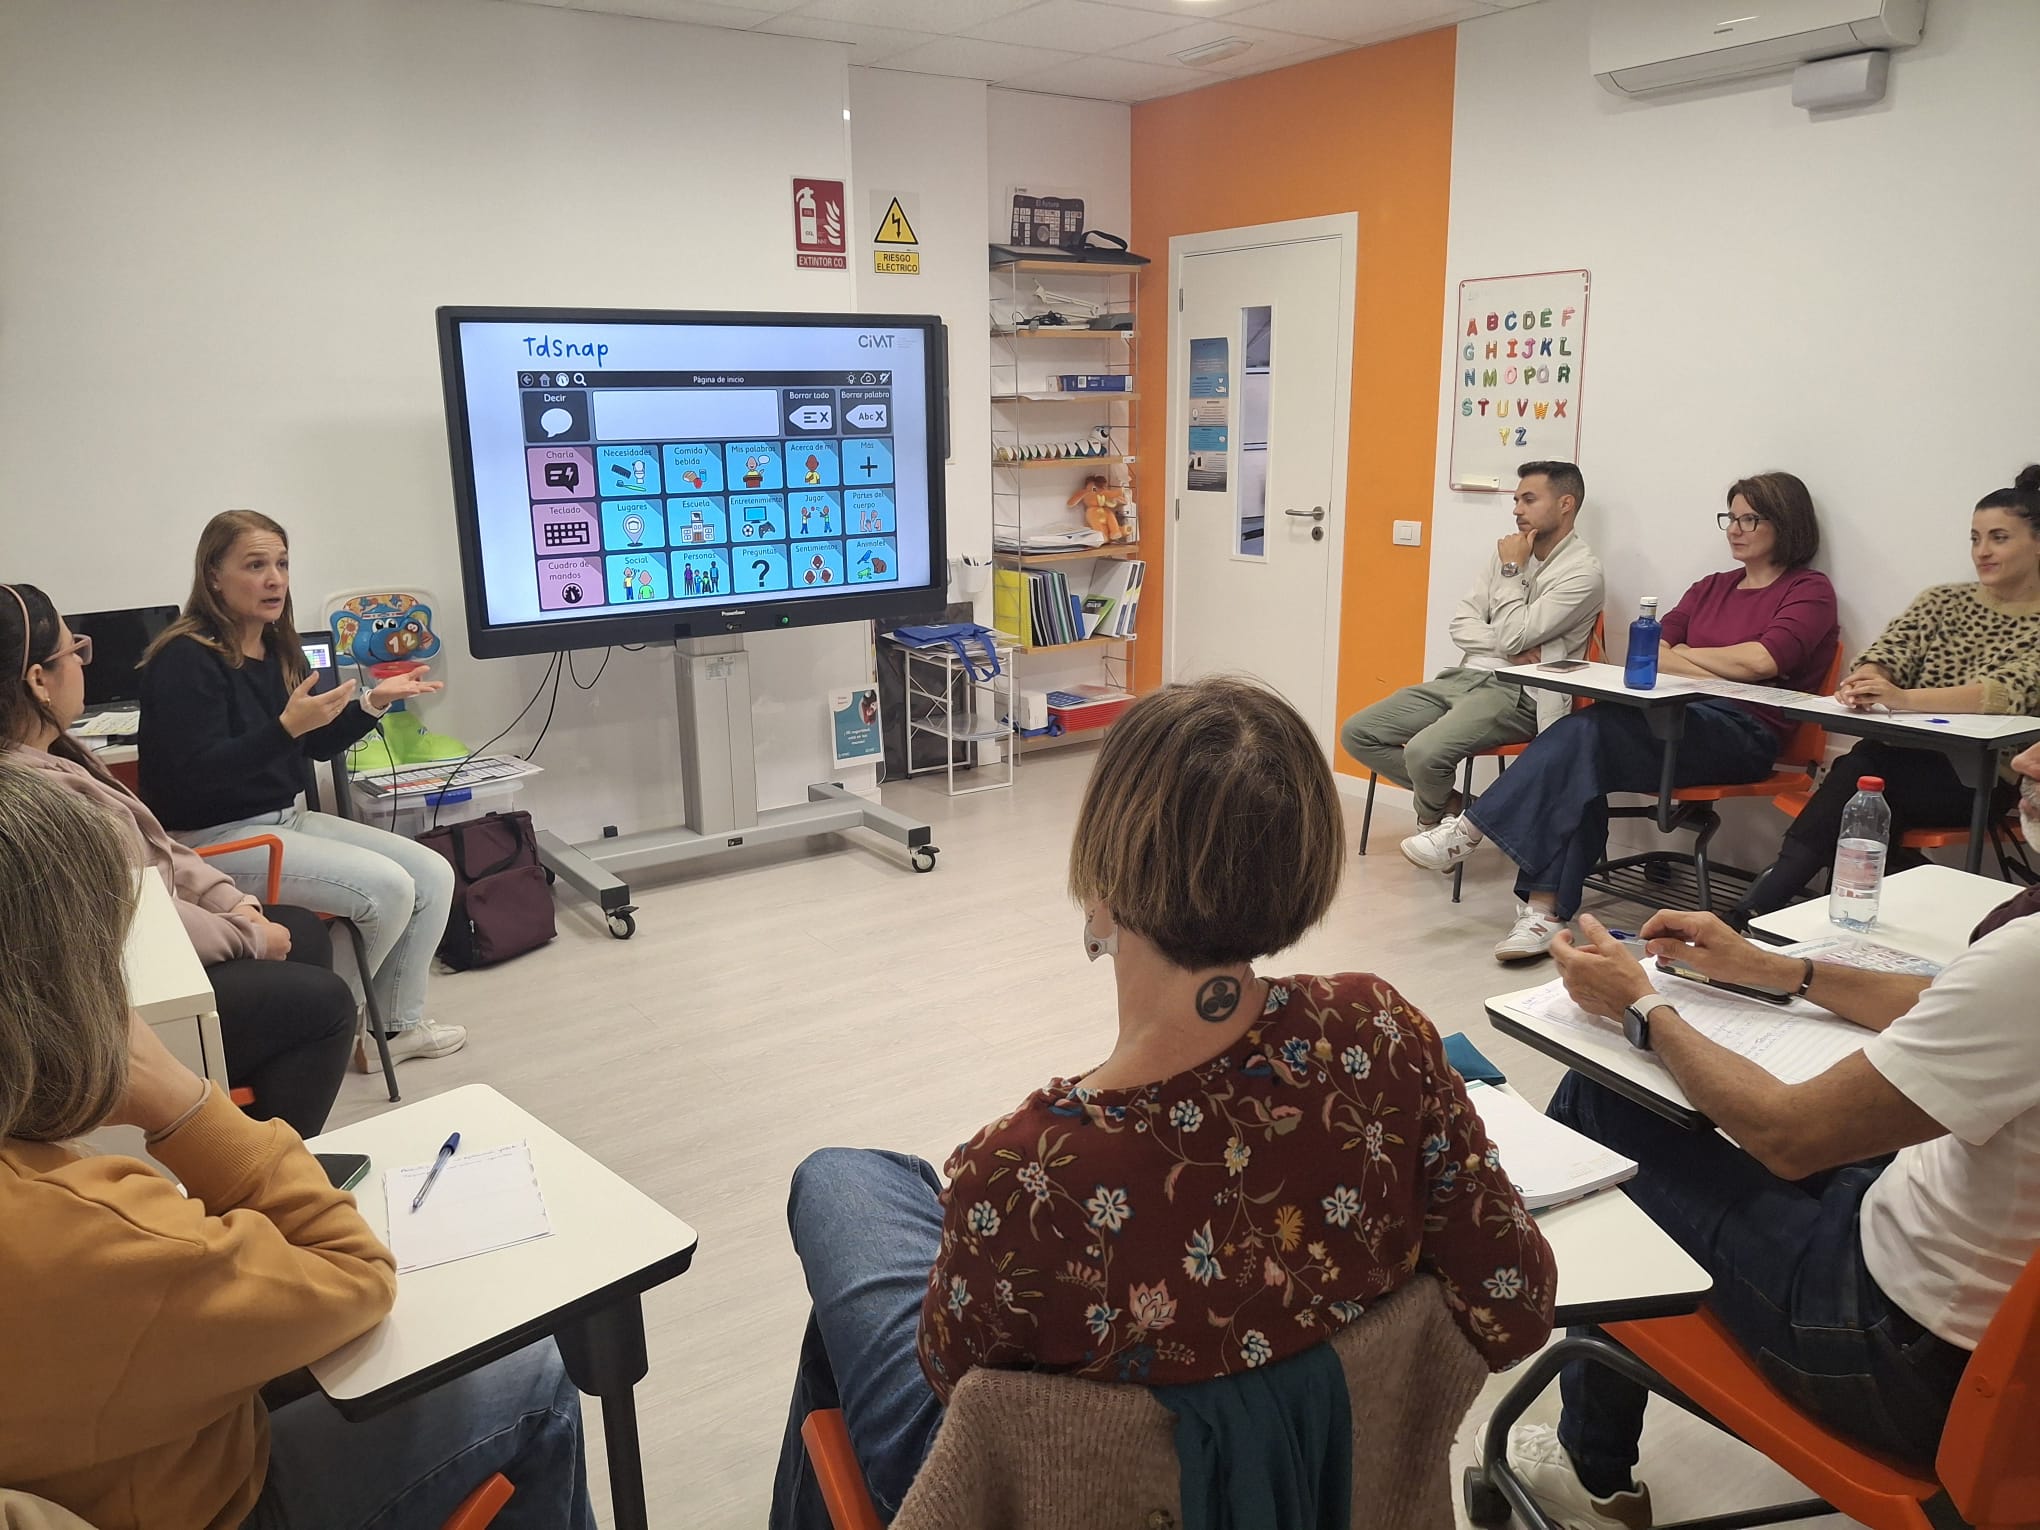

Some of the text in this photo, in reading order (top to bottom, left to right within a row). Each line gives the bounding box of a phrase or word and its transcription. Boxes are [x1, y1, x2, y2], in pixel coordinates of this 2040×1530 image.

[799, 256, 833, 268] EXTINTOR
[883, 253, 911, 263] RIESGO
[876, 263, 918, 273] ELECTRICO
[1466, 306, 1576, 336] A B C D E F
[523, 335, 609, 368] TdSnap
[1463, 337, 1572, 361] G H I J K L
[727, 376, 745, 384] inicio
[1464, 368, 1476, 387] N
[1483, 369, 1498, 388] M
[1504, 366, 1518, 384] O
[1524, 365, 1536, 385] P
[543, 393, 566, 402] Decir
[789, 391, 830, 400] Borrar todo
[841, 391, 890, 401] Borrar palabra
[1462, 398, 1568, 419] S T U V W X
[858, 412, 874, 422] Abc
[1499, 428, 1511, 446] Y
[674, 447, 709, 456] Comida y
[731, 445, 776, 454] Mis palabras
[791, 443, 814, 451] Acerca
[546, 450, 574, 459] Charla
[603, 449, 652, 457] Necesidades
[675, 458, 700, 466] bebida
[805, 494, 824, 503] Jugar
[852, 490, 884, 500] Partes del
[682, 500, 710, 508] Escuela
[730, 496, 783, 505] Entretenimiento
[550, 506, 581, 515] Teclado
[617, 503, 648, 512] Lugares
[853, 502, 876, 510] cuerpo
[795, 544, 838, 553] Sentimientos
[856, 540, 886, 548] Animales
[624, 556, 649, 565] Social
[683, 552, 717, 560] Personas
[548, 561, 578, 570] Cuadro
[549, 573, 582, 581] mandos
[388, 632, 416, 654] 1 2
